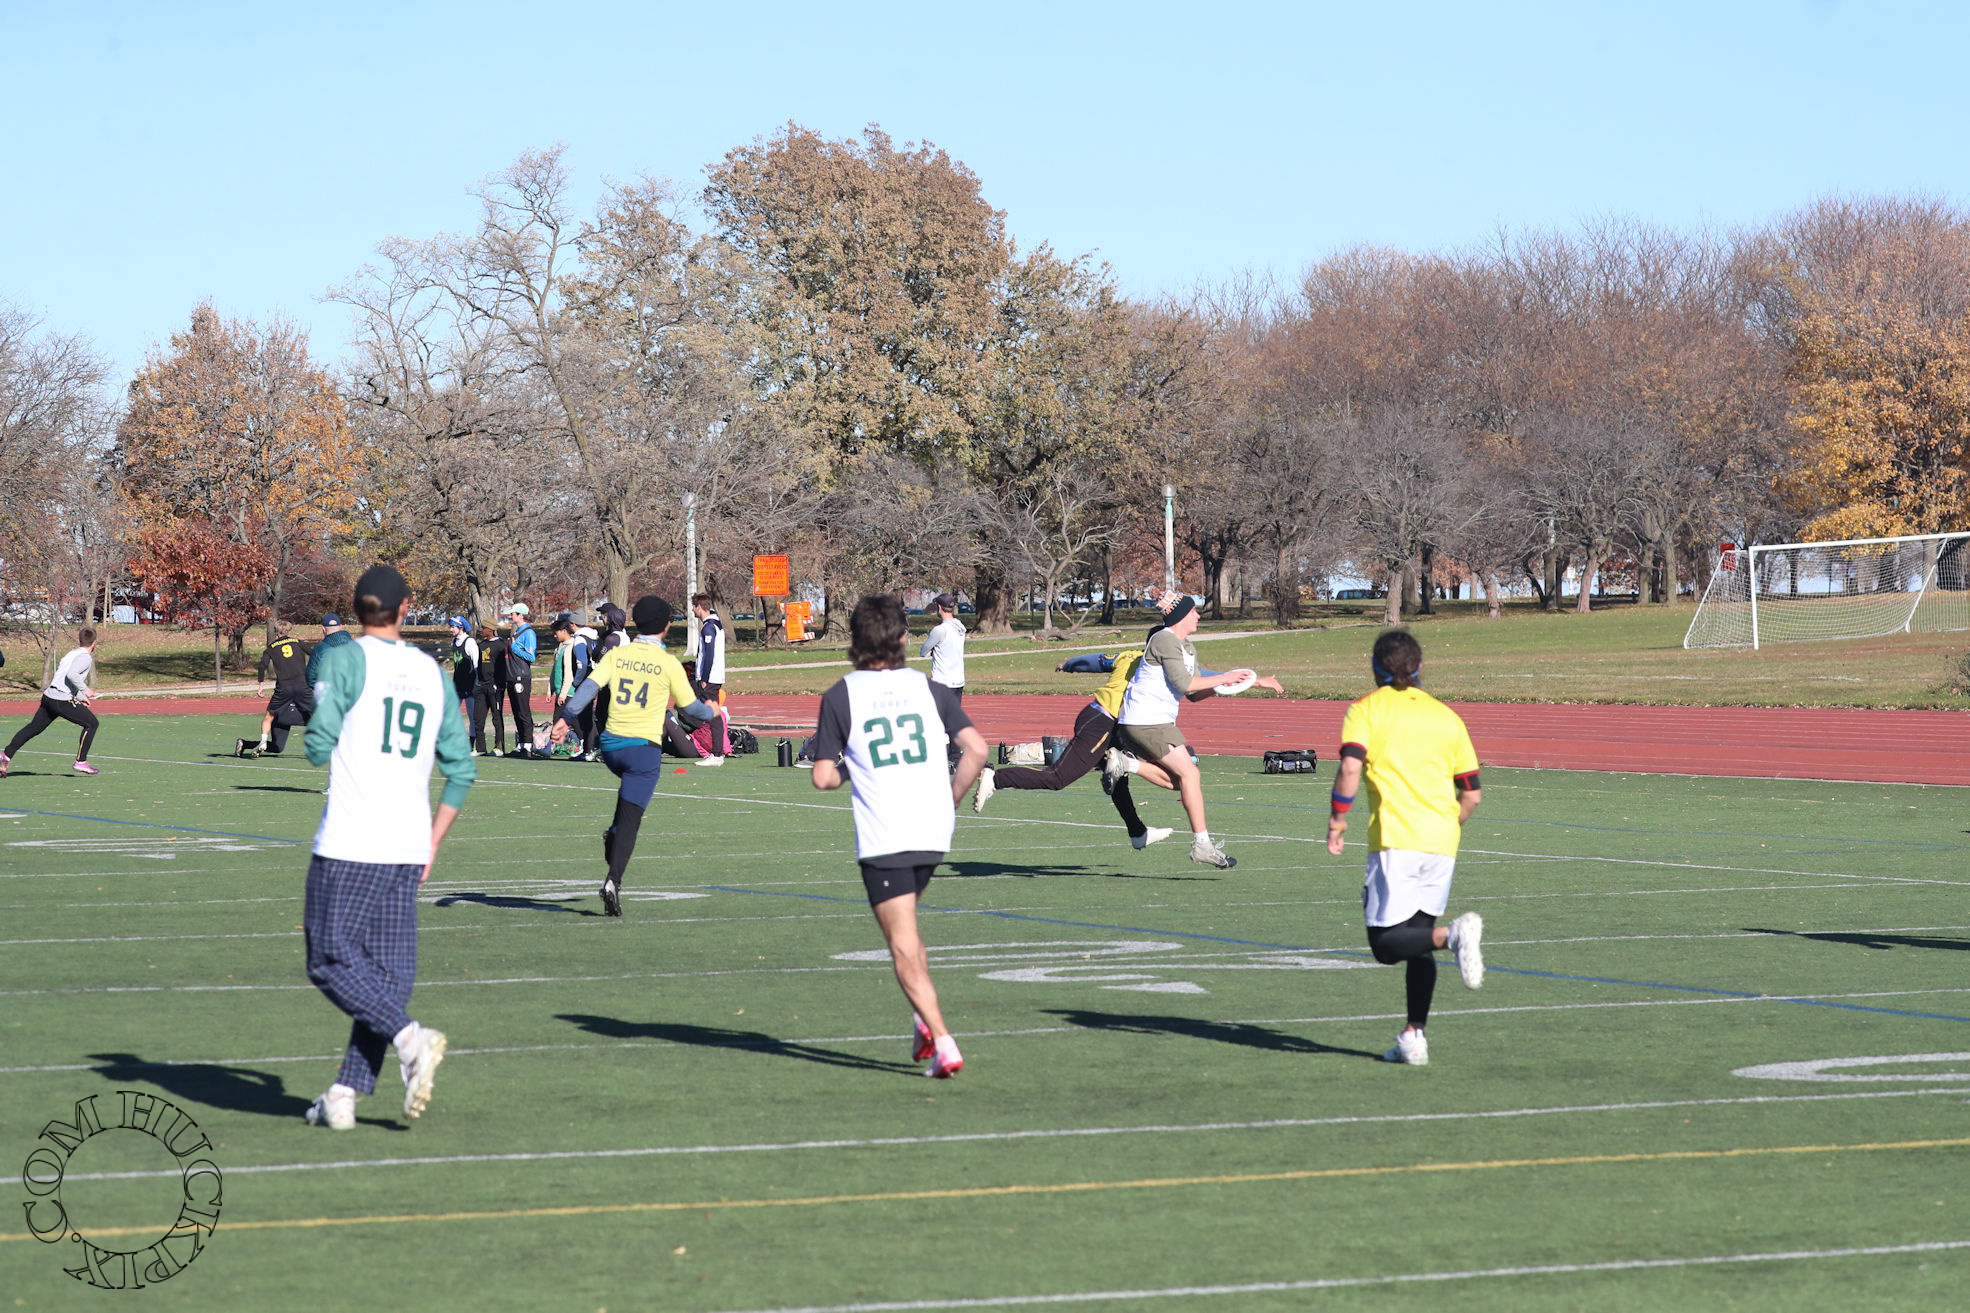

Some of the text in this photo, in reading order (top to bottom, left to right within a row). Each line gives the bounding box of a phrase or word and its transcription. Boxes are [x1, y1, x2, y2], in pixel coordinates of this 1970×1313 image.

[281, 644, 293, 658] 9
[616, 659, 662, 676] CHICAGO
[616, 678, 649, 709] 54
[381, 697, 425, 759] 19
[863, 713, 928, 768] 23
